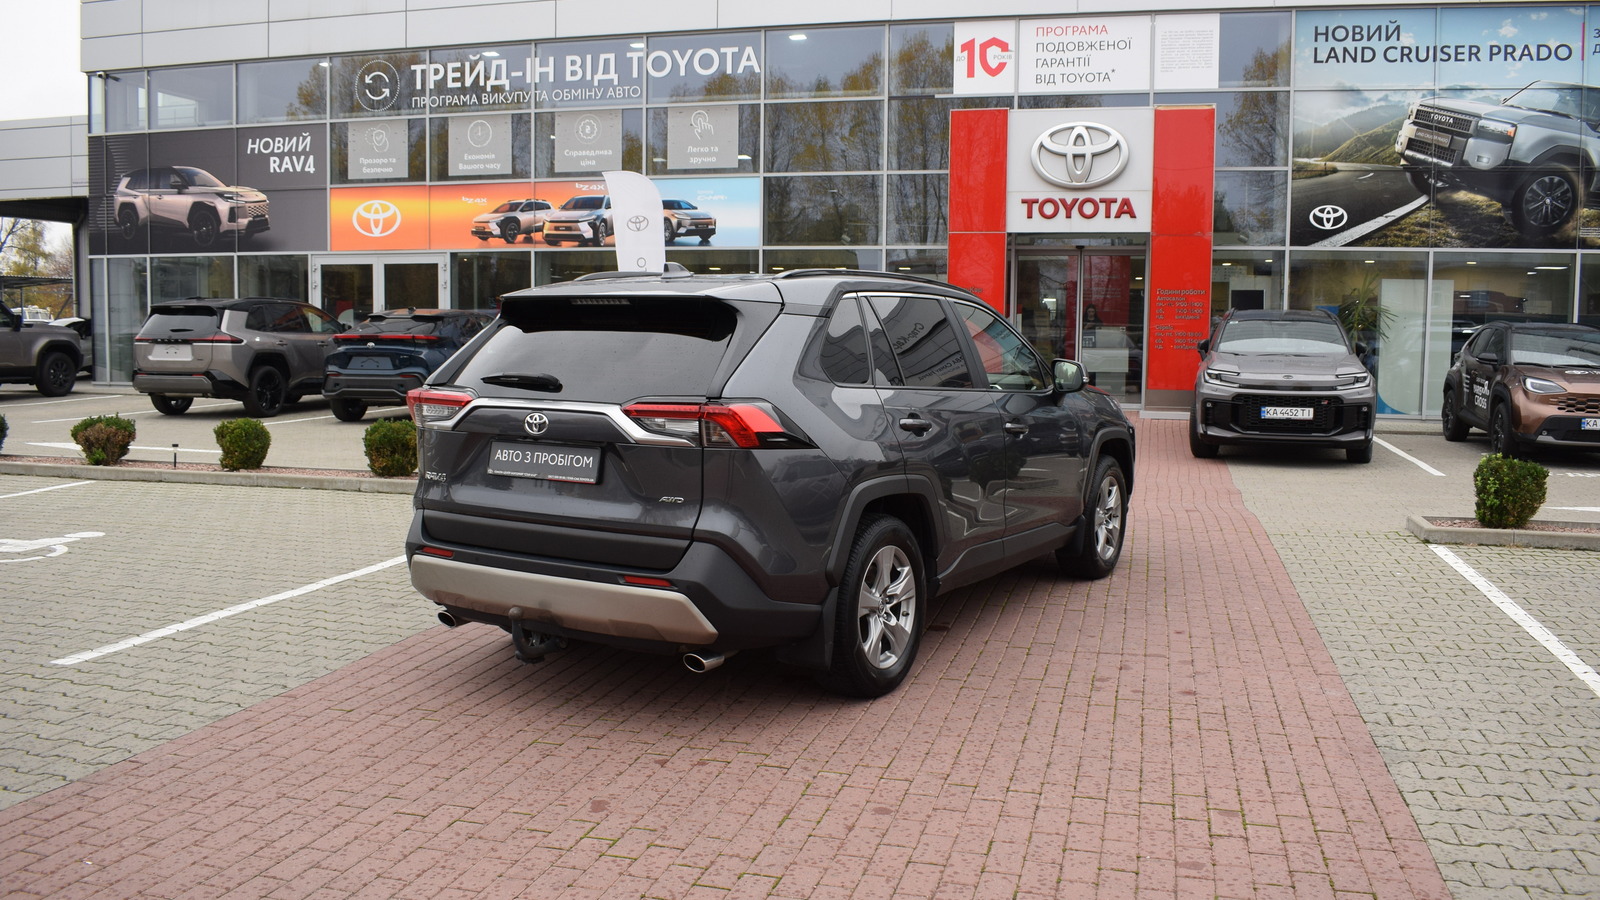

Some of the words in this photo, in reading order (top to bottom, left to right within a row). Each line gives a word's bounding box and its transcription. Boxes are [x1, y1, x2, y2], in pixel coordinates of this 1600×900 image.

[1036, 24, 1108, 37] ПРОГРАМА
[1313, 20, 1402, 42] НОВИЙ
[1035, 37, 1132, 54] ПОДОВЖЕНОЇ
[1313, 46, 1376, 64] LAND
[1383, 45, 1481, 63] CRUISER
[1488, 43, 1573, 62] PRADO
[1035, 54, 1091, 69] ГАРАНТІЇ
[410, 55, 555, 92] ТРЕЙД-ІН
[564, 53, 618, 85] ВІД
[626, 47, 762, 78] TOYOTA
[1035, 72, 1056, 86] ВІД
[411, 92, 479, 108] ПРОГРАМА
[481, 90, 532, 106] ВИКУПУ
[533, 90, 549, 102] ТА
[551, 87, 605, 102] ОБМІНУ
[606, 85, 641, 99] АВТО
[1430, 113, 1454, 124] TOYOTA
[246, 132, 312, 154] НОВИЙ
[687, 145, 709, 153] Легко
[464, 152, 496, 160] Економія
[564, 149, 613, 157] Справедлива
[689, 156, 717, 164] зручно
[269, 155, 316, 174] RAV4
[359, 157, 388, 165] Прозоро
[485, 162, 501, 170] часу
[362, 166, 393, 174] безпечно
[1021, 197, 1137, 219] TOYOTA
[1279, 409, 1299, 417] 4452
[494, 449, 522, 462] АВТО
[524, 451, 532, 463] З
[533, 452, 593, 468] ПРОБІГОМ
